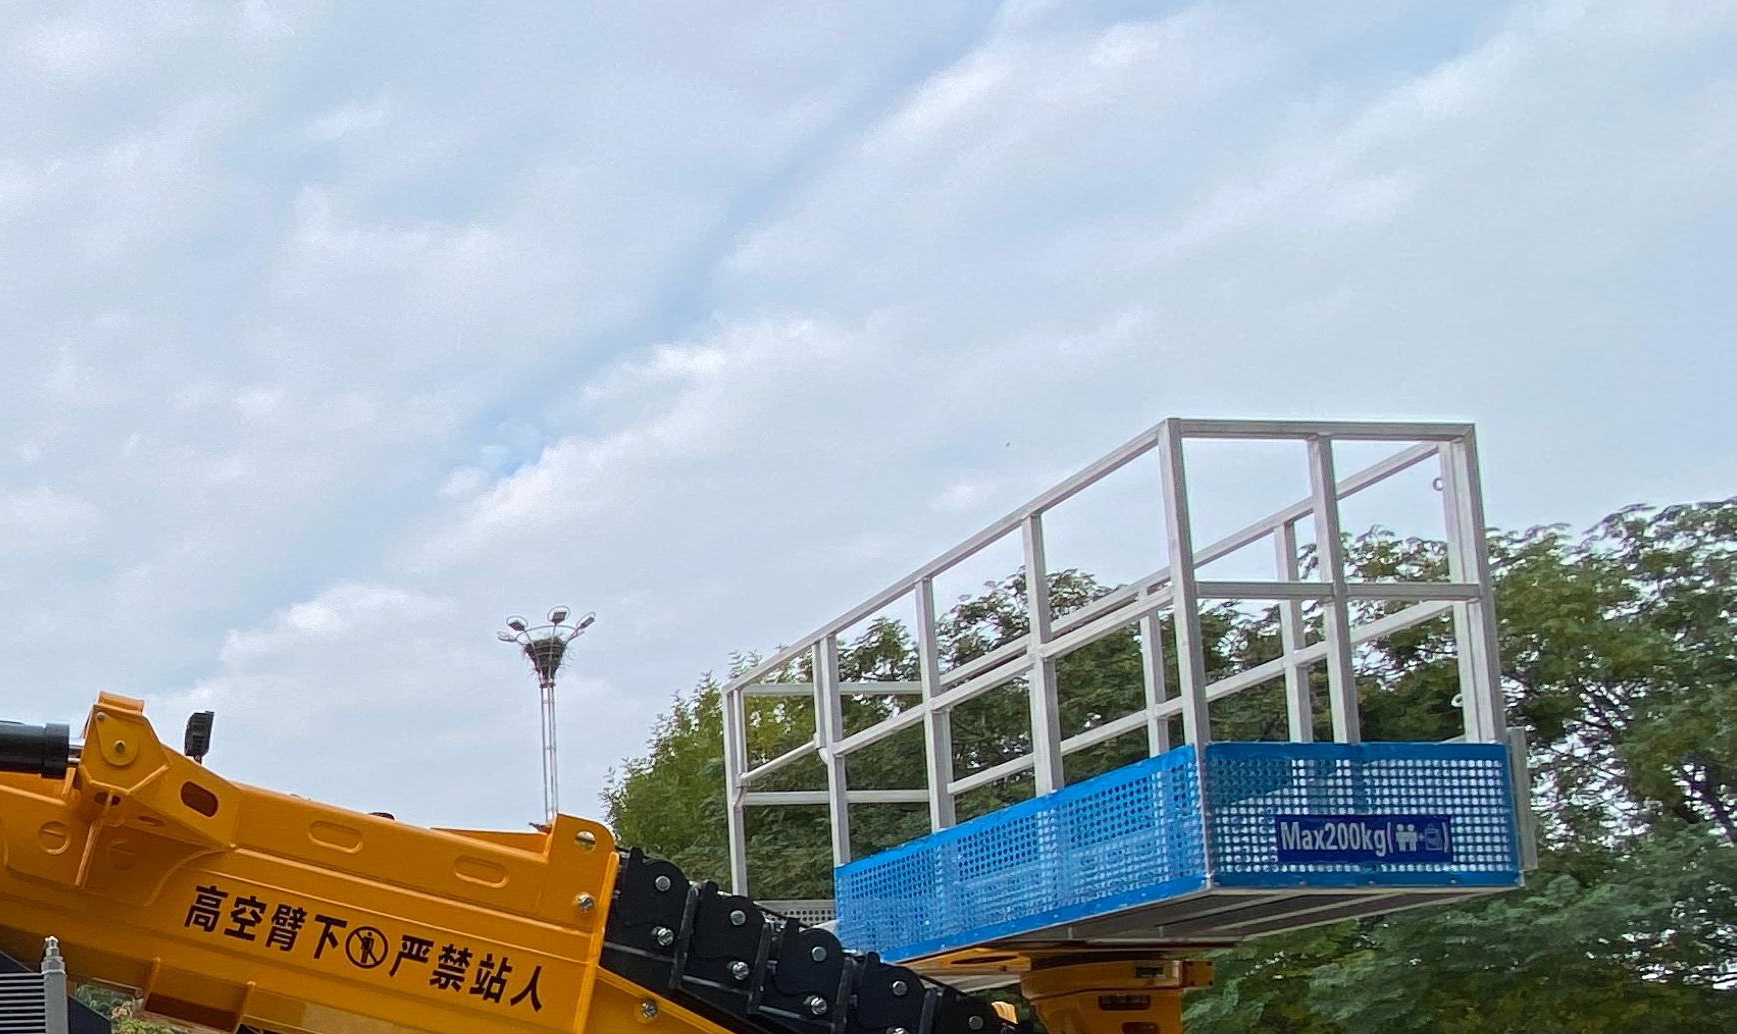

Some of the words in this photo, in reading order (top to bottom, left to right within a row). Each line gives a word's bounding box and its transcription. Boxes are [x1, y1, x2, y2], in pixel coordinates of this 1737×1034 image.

[184, 885, 347, 961] 高空臂下
[388, 934, 543, 1013] 严禁站人
